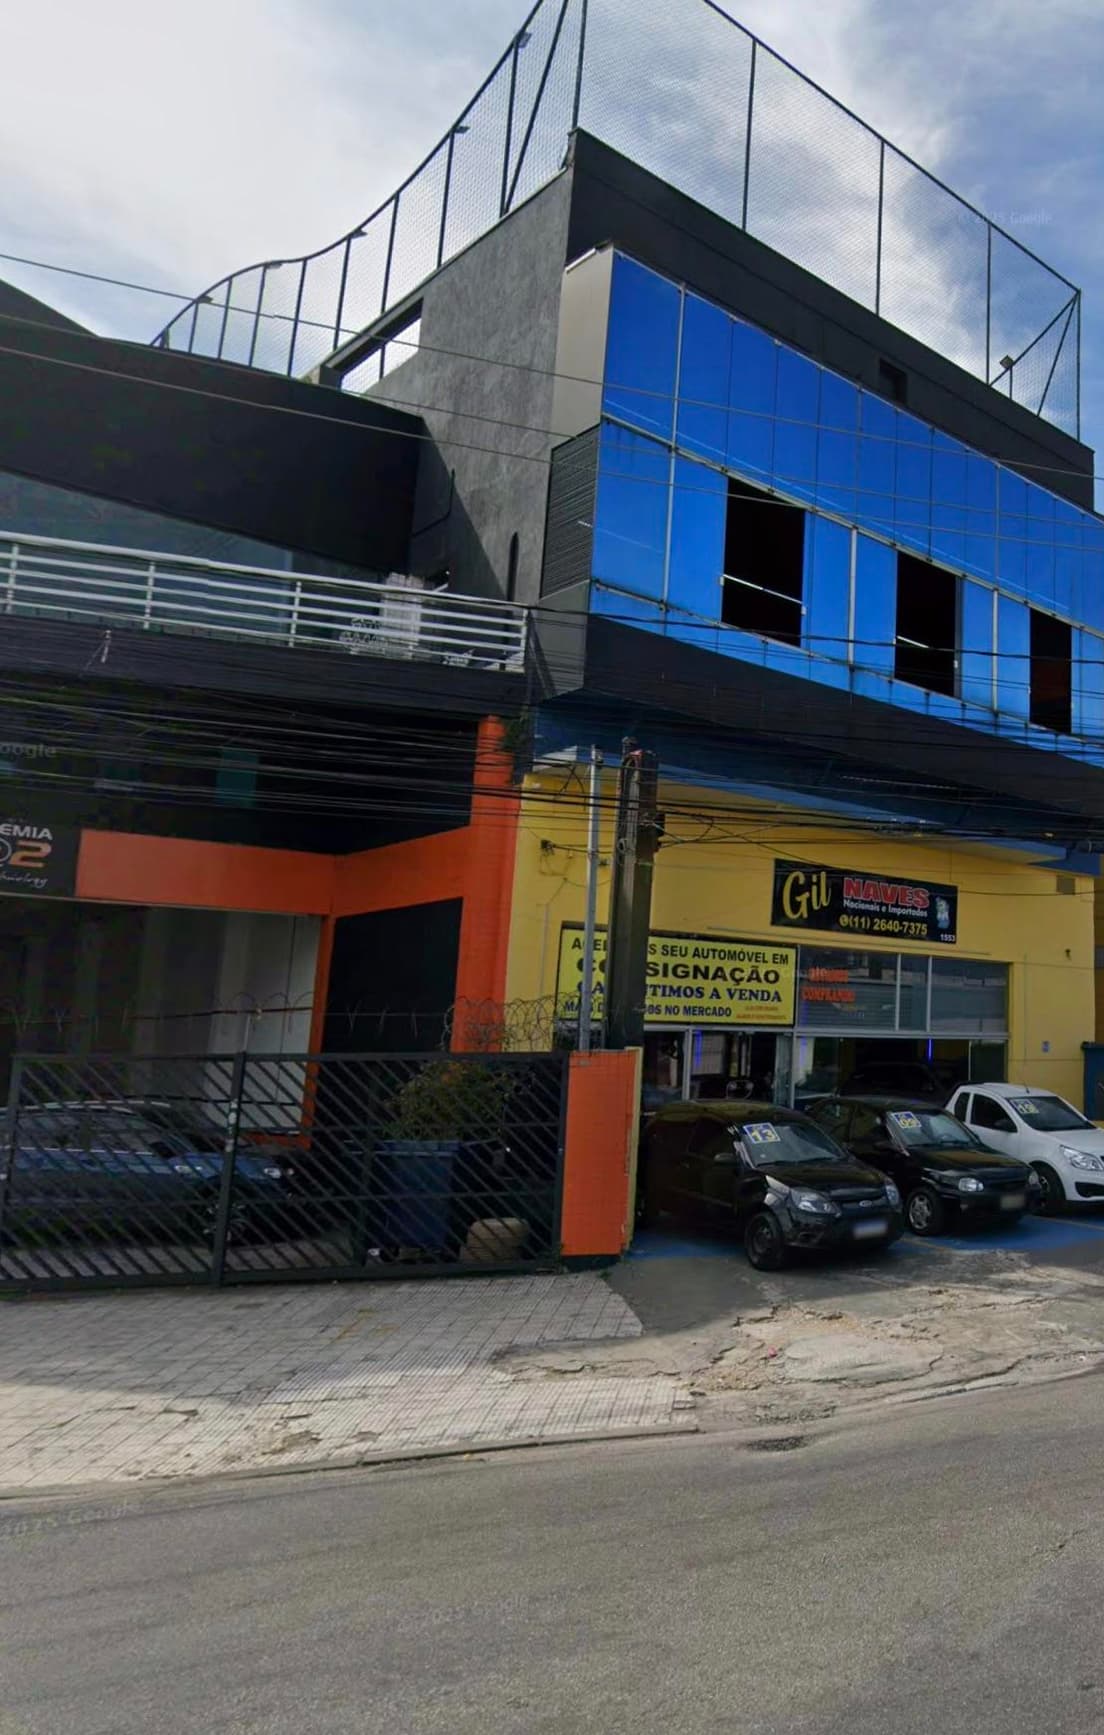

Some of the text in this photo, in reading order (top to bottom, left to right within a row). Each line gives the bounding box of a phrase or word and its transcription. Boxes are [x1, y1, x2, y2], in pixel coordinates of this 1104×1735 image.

[782, 871, 930, 920] Gil NAVES
[843, 899, 880, 912] Nacionais
[888, 905, 928, 917] Importados
[849, 916, 928, 936] (11) 2640-7375
[661, 944, 688, 957] SEU
[693, 945, 768, 964] AUTOMÓVEL
[772, 953, 789, 965] EM
[710, 985, 721, 999] A
[727, 986, 782, 1003] VENDA
[664, 1005, 680, 1016] NO
[683, 1005, 732, 1017] MERCADO
